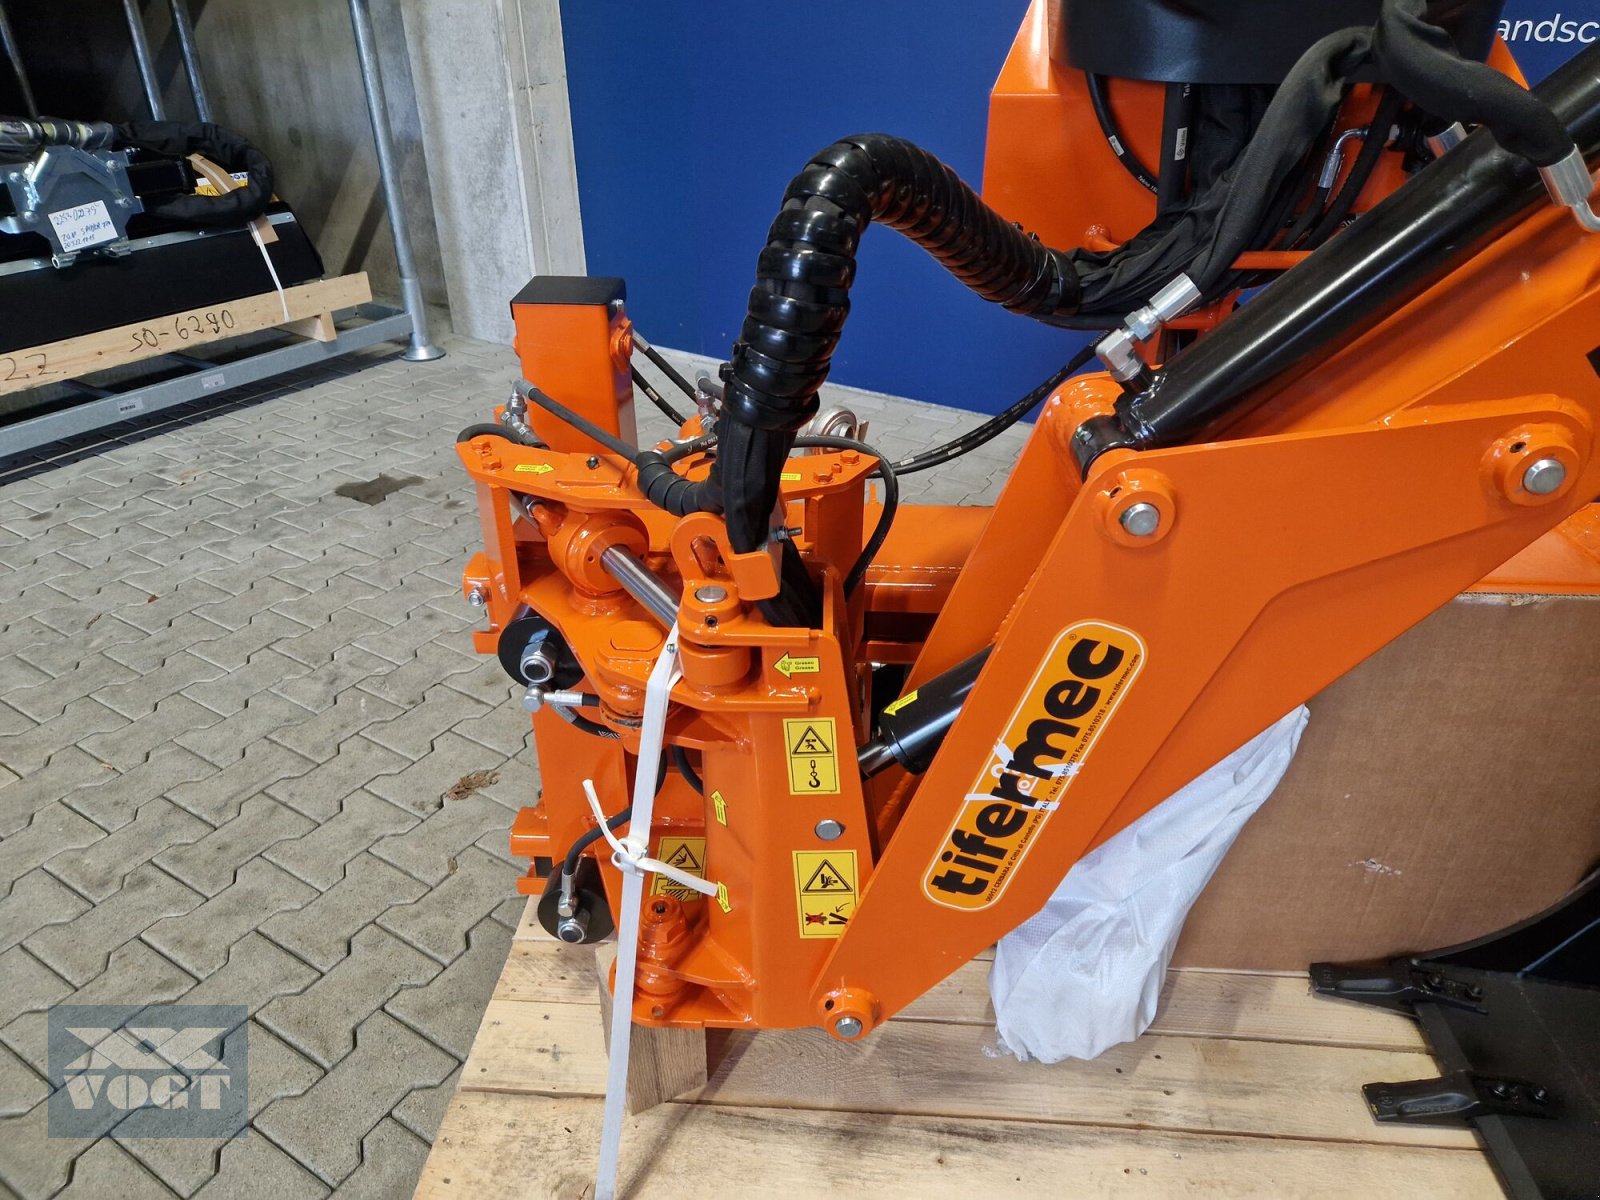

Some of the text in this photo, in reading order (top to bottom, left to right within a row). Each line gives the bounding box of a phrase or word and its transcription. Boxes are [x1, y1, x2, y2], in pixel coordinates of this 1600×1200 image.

[931, 638, 1124, 895] tifermec
[1038, 797, 1051, 813] ITALY
[1075, 742, 1084, 753] Fax
[1104, 652, 1140, 705] www.tifermec.com
